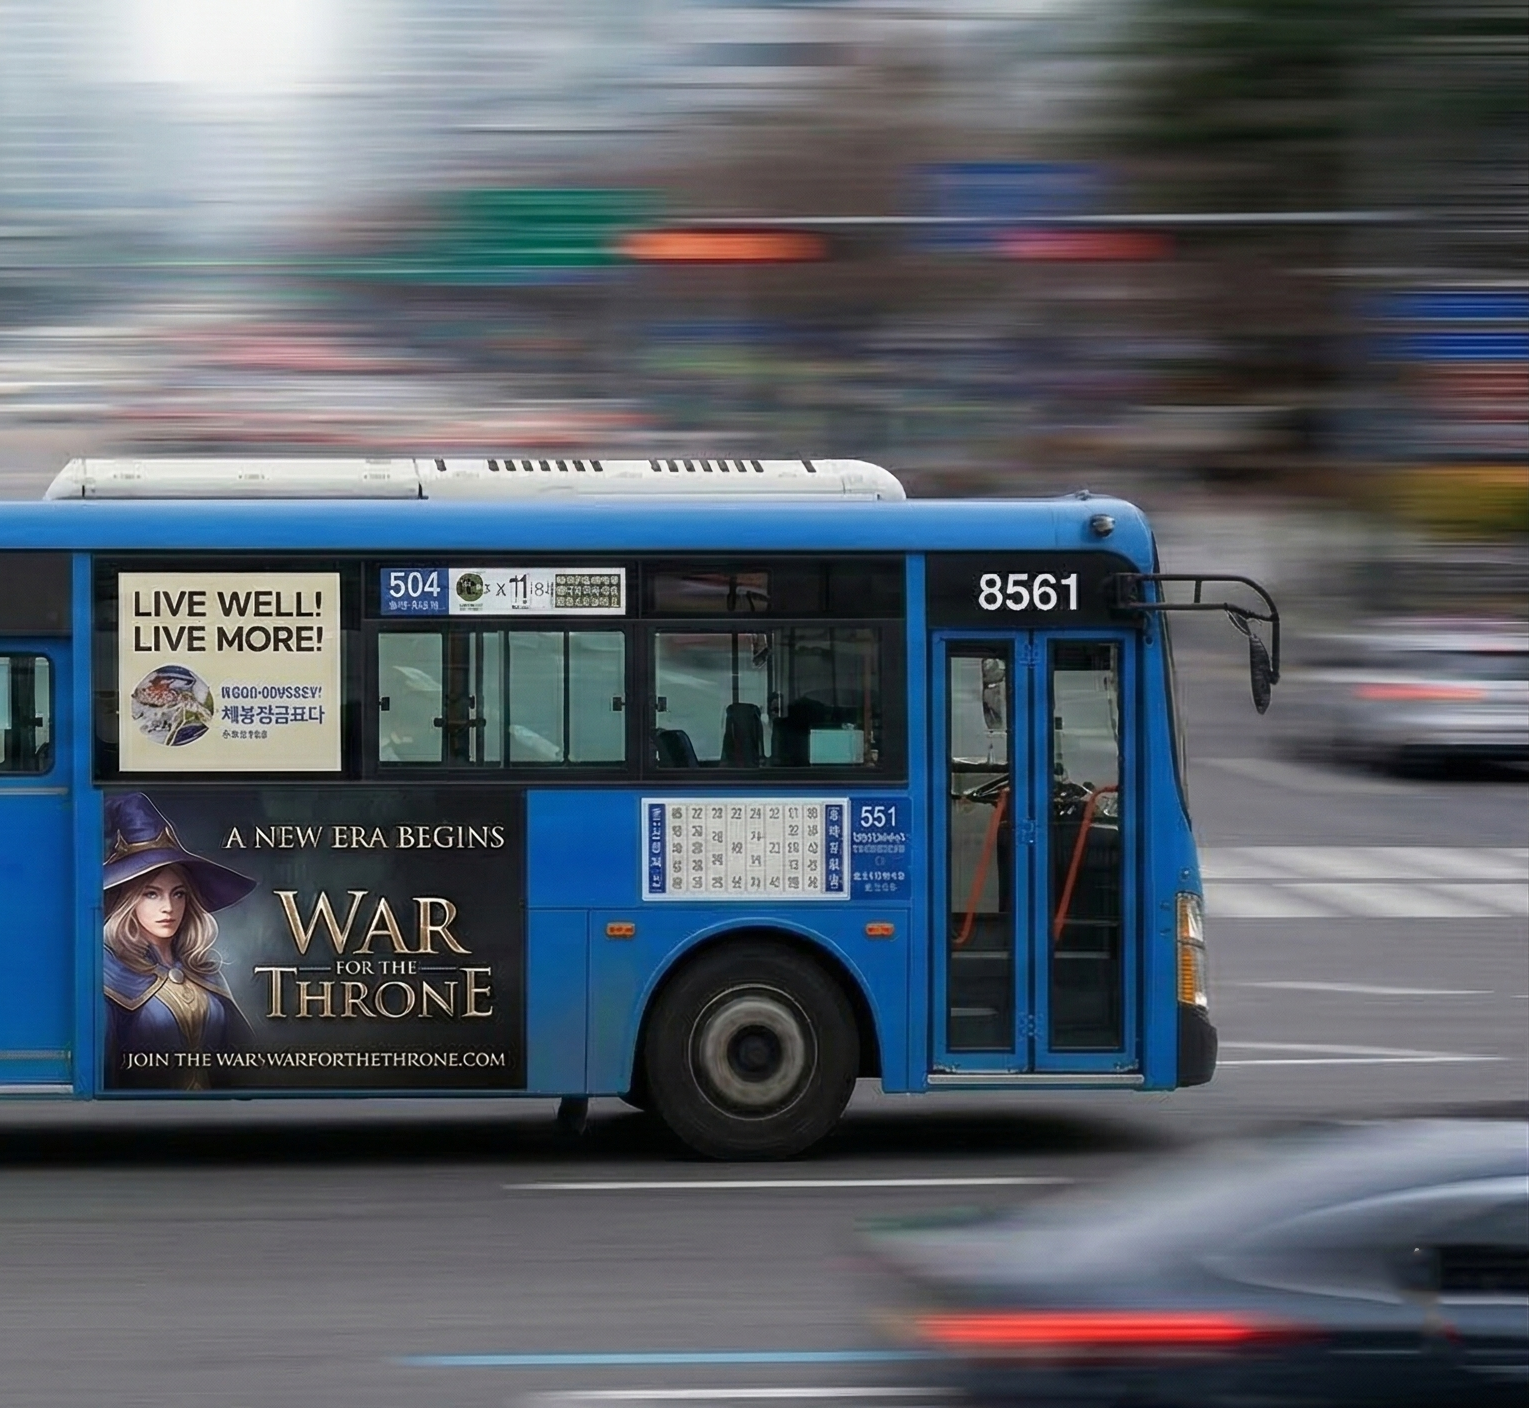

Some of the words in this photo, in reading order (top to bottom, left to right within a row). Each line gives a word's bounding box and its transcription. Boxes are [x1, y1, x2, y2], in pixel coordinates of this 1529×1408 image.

[389, 571, 441, 598] 504
[978, 573, 1080, 611] 8561
[134, 591, 207, 617] LIVE
[217, 591, 322, 617] WELL!
[134, 626, 207, 652] LIVE
[217, 626, 323, 652] MORE!
[860, 806, 896, 828] 551
[225, 826, 246, 849] A
[255, 826, 322, 849] NEW
[332, 826, 388, 849] ERA
[396, 826, 505, 849] BEGINS
[274, 890, 472, 955] WAR
[336, 962, 374, 976] FOR
[378, 961, 417, 975] THE
[254, 966, 494, 1018] THRONE
[127, 1053, 169, 1069] JOIN
[174, 1053, 211, 1067] THE
[267, 1053, 505, 1068] WARFORTHETHRONE.COM
